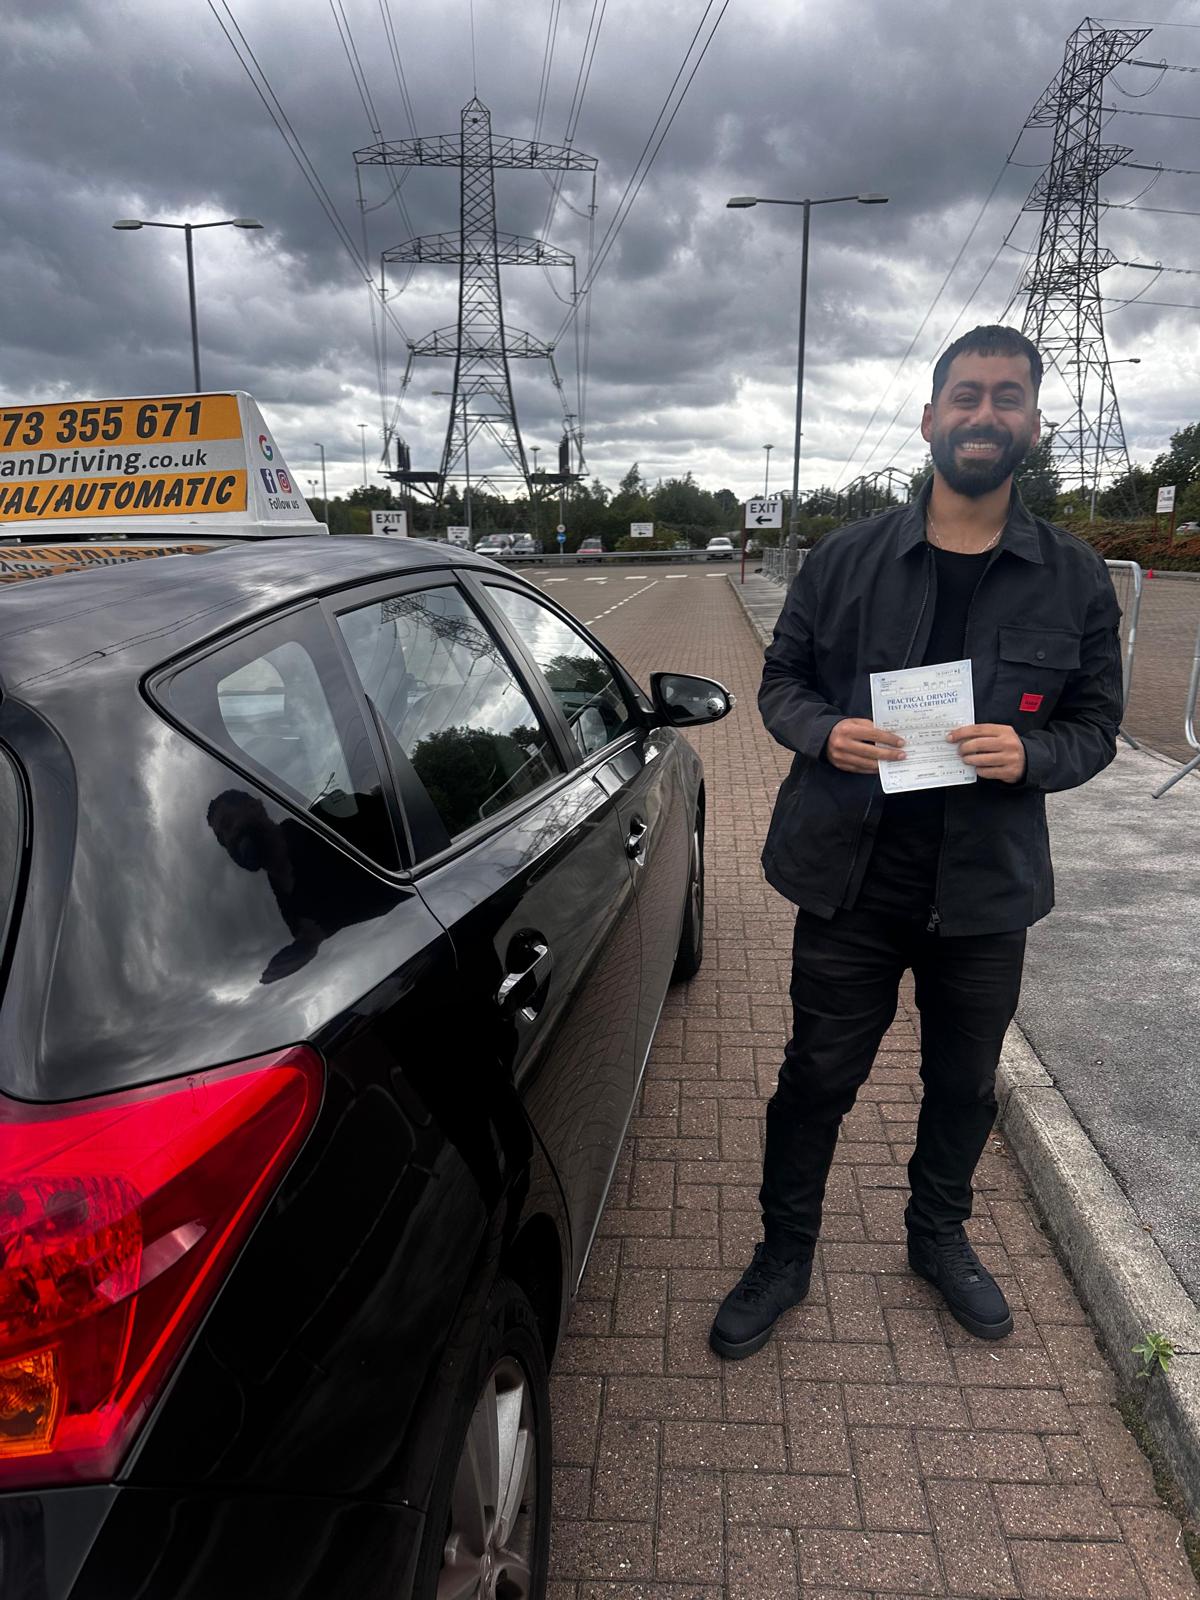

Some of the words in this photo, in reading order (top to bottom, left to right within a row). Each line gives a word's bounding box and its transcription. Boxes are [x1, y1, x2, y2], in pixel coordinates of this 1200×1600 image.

[0, 412, 45, 446] 73
[56, 406, 123, 443] 355
[136, 401, 201, 438] 671
[0, 449, 207, 477] anDriving.co.uk
[268, 498, 291, 510] Follow
[292, 500, 300, 510] us
[750, 503, 778, 513] EXIT
[376, 513, 402, 524] EXIT
[887, 696, 924, 704] PRACTICAL
[926, 691, 958, 700] DRIVING
[920, 697, 957, 707] CERTIFICATE
